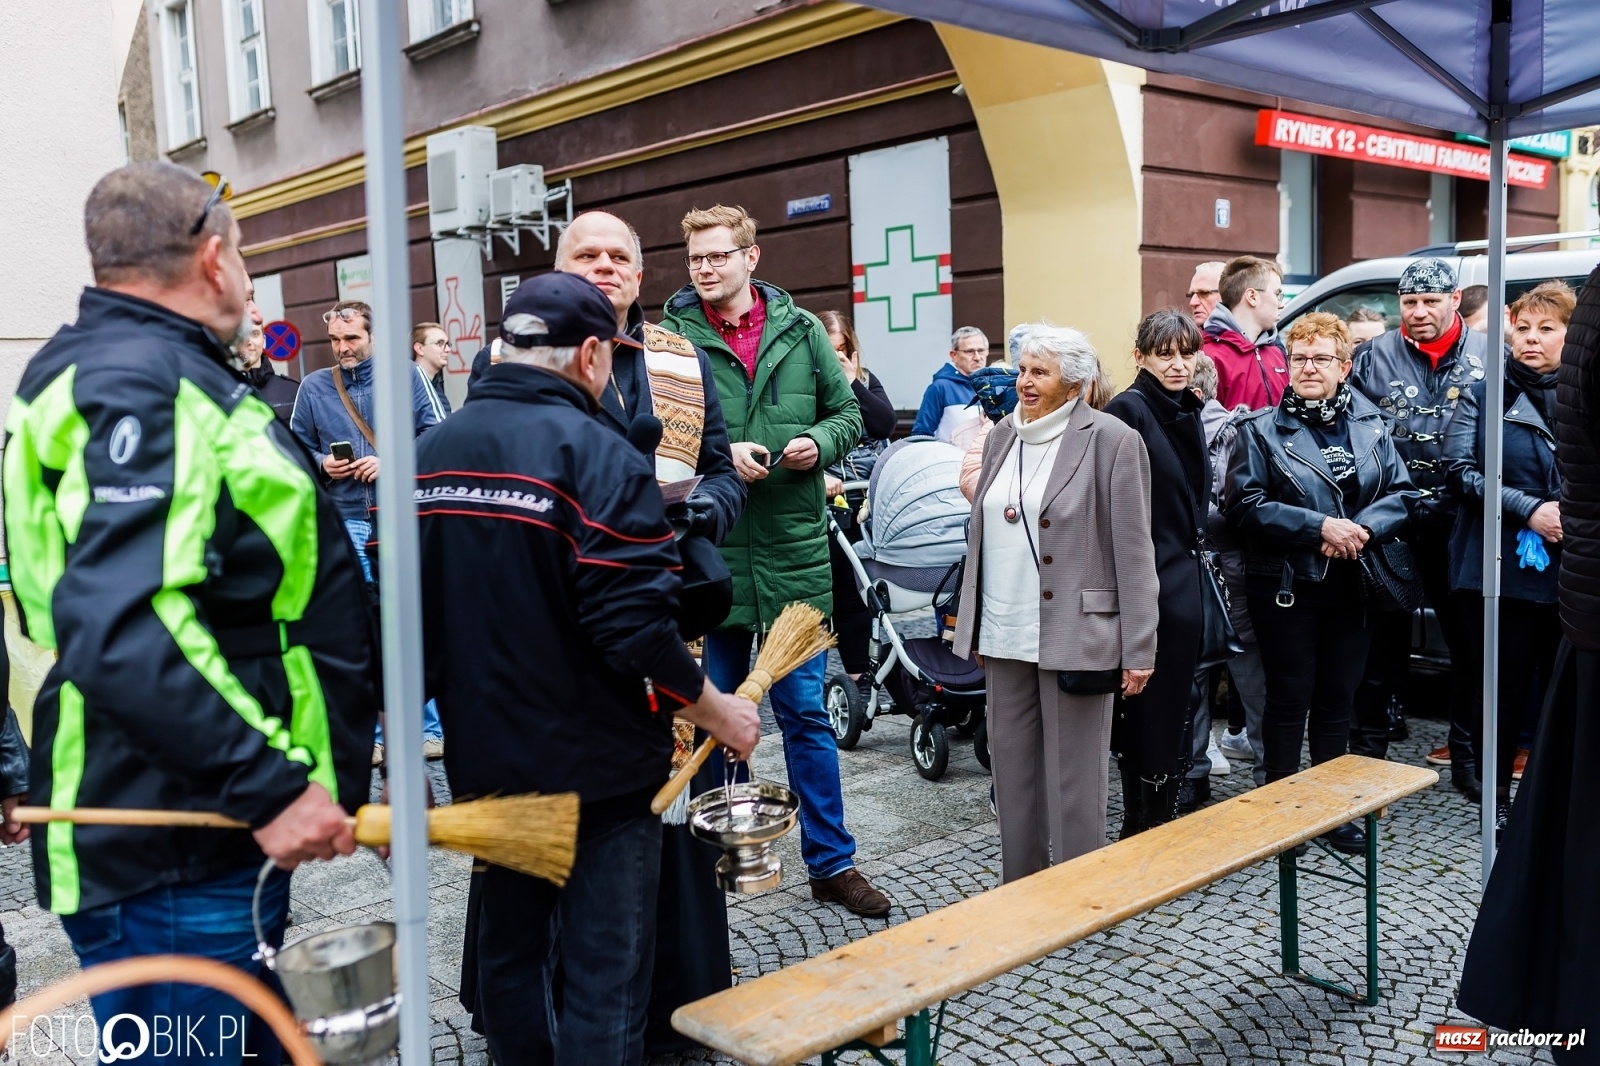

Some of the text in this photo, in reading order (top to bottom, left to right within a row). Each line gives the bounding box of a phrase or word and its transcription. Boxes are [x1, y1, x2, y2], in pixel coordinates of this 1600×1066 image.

[1275, 118, 1334, 149] RYNEK
[1336, 129, 1356, 152] 12
[1366, 134, 1436, 165] CENTRUM
[413, 486, 550, 512] RLEY-DAVIDSON
